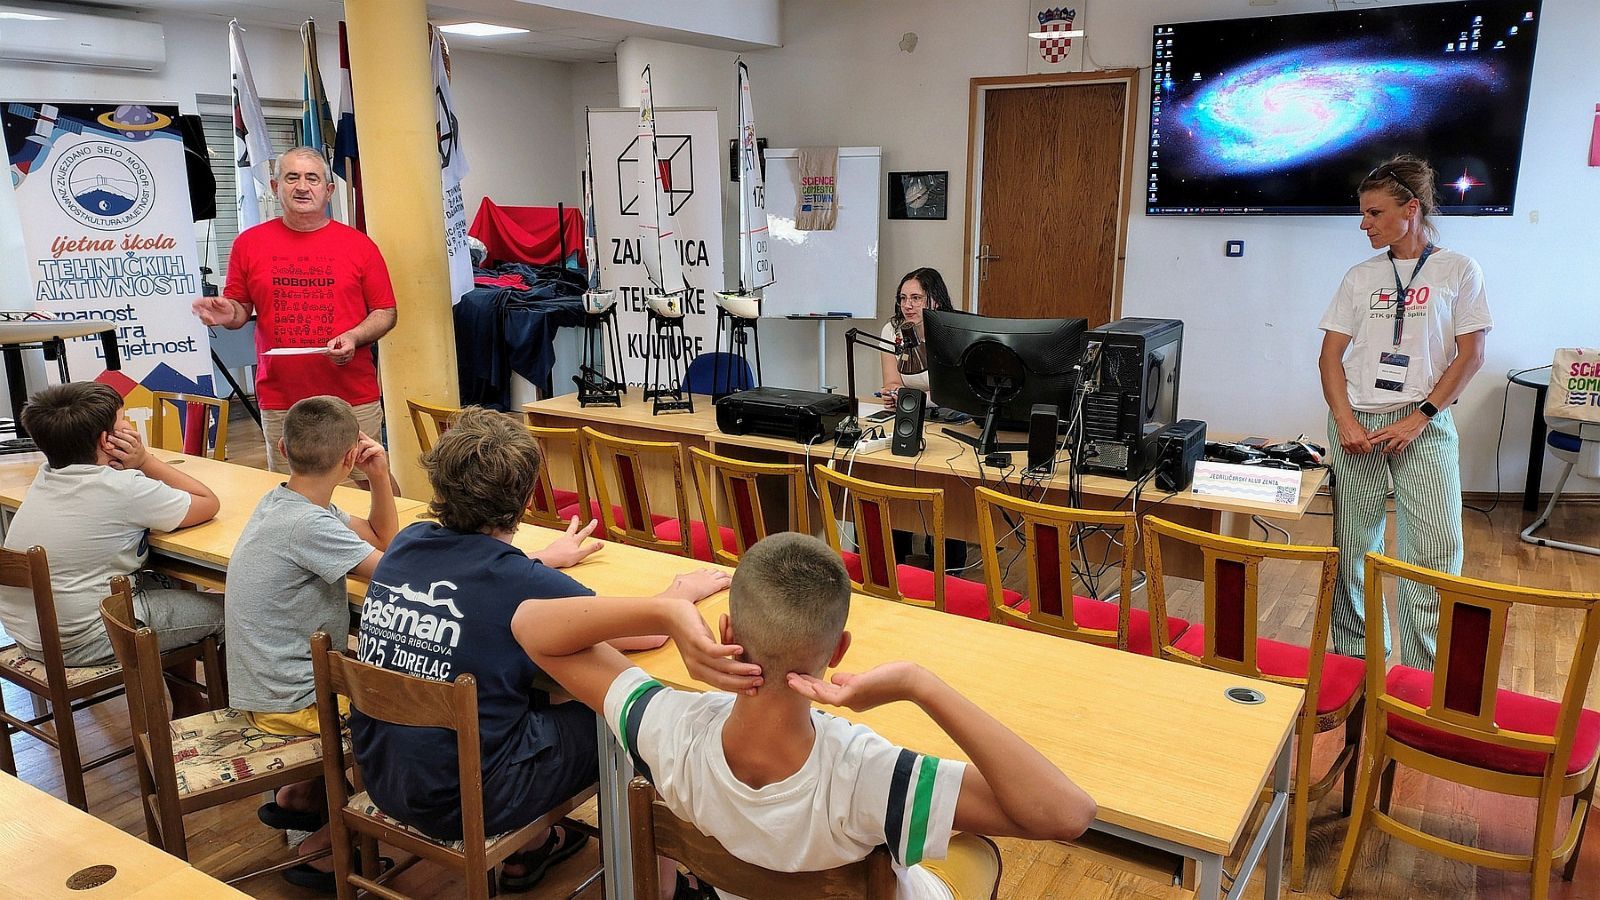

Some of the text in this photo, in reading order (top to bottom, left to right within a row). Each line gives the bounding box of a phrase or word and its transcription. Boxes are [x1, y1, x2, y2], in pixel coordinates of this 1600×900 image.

[57, 145, 149, 187] ZVJEZDANO SELO MOSOR
[802, 176, 834, 186] SCIENCE
[58, 188, 150, 226] ZNANOST KULTURA UMJETNOST
[813, 194, 834, 203] TOWN
[51, 233, 177, 258] ljetna škola
[611, 238, 709, 267] ZAJICA
[38, 251, 186, 281] TEHNIČKIH
[36, 274, 195, 301] AKTIVNOSTI
[272, 277, 335, 287] ROBOKUP
[1568, 377, 1600, 391] COM
[368, 625, 407, 644] PODVODNOG
[408, 637, 452, 656] RIBOLOVA
[391, 643, 452, 679] ŽDRELAC
